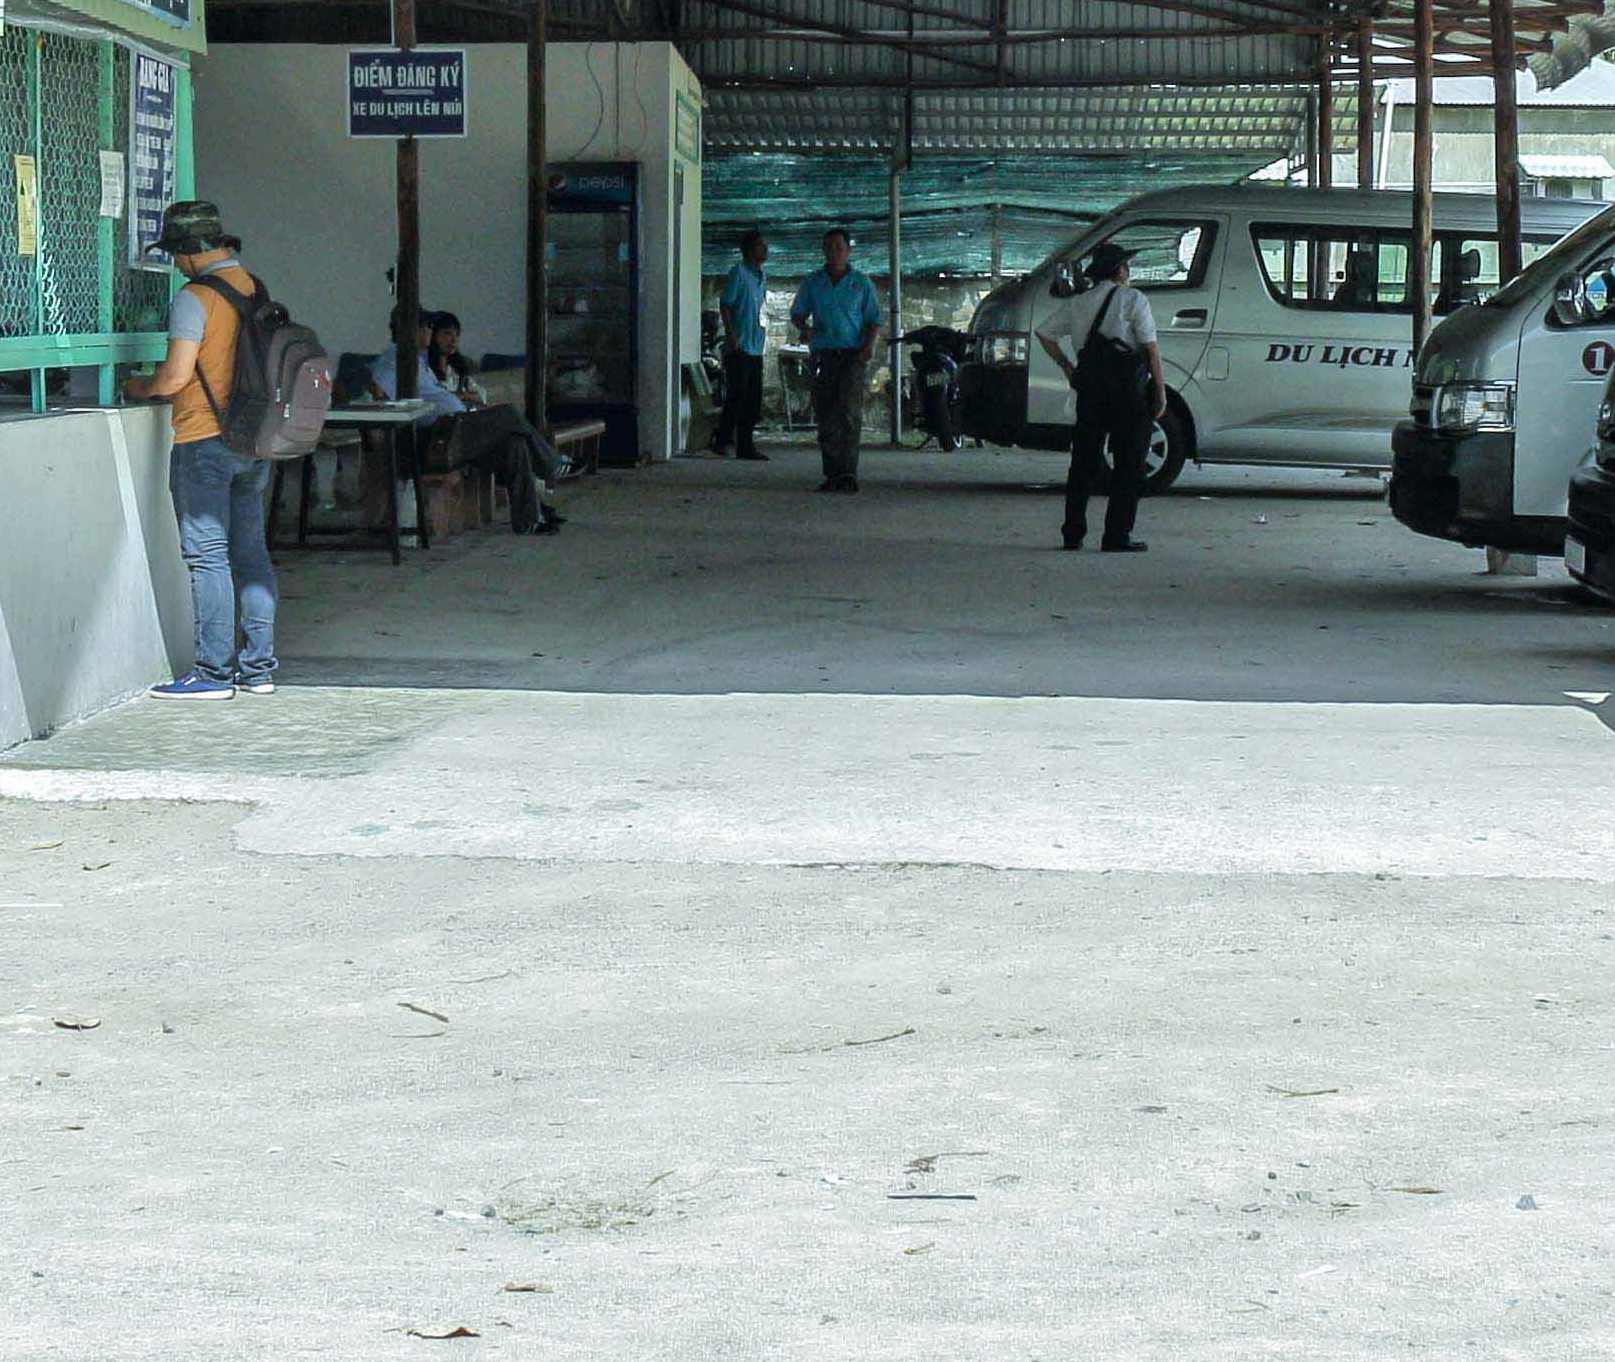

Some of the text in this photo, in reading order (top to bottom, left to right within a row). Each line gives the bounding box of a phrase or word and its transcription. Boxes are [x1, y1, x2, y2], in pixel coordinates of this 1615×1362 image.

[441, 62, 459, 87] KÝ
[353, 102, 367, 115] XE
[370, 102, 385, 115] DU
[1266, 344, 1314, 362] DU
[1320, 346, 1398, 368] LỊCH
[1590, 347, 1607, 371] 1
